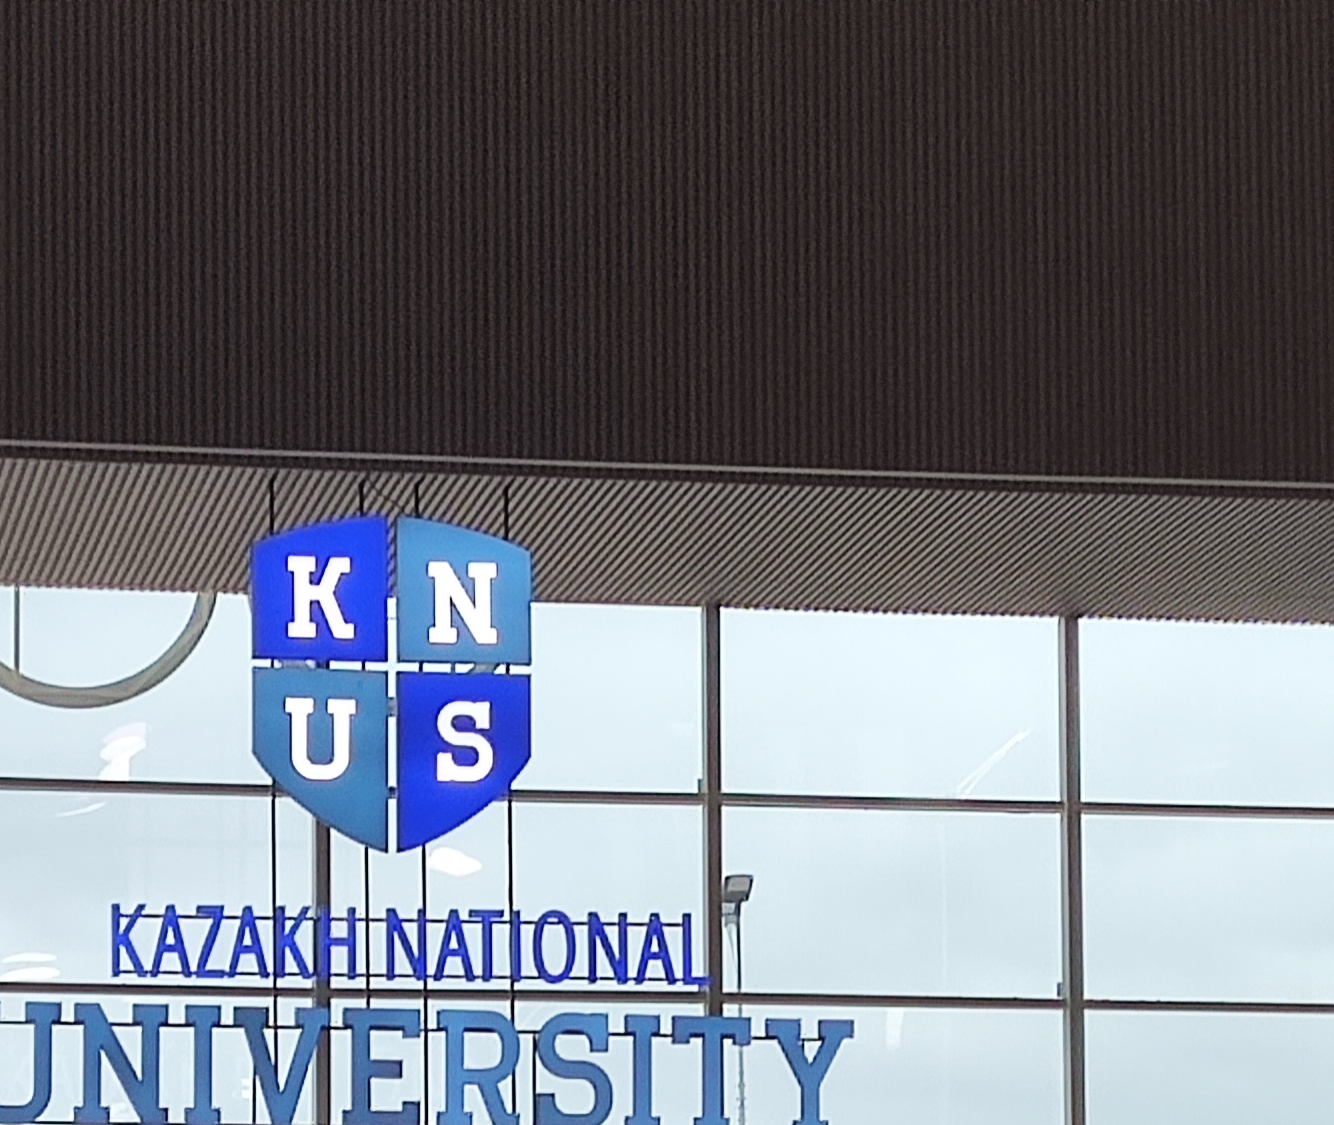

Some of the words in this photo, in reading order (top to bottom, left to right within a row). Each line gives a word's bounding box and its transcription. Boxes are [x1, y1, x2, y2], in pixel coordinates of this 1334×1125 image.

[285, 556, 355, 640] K
[427, 561, 498, 645] N
[284, 698, 356, 781] U
[436, 701, 494, 783] S
[111, 903, 357, 981] KAZAKH
[385, 907, 712, 988] NATIONAL
